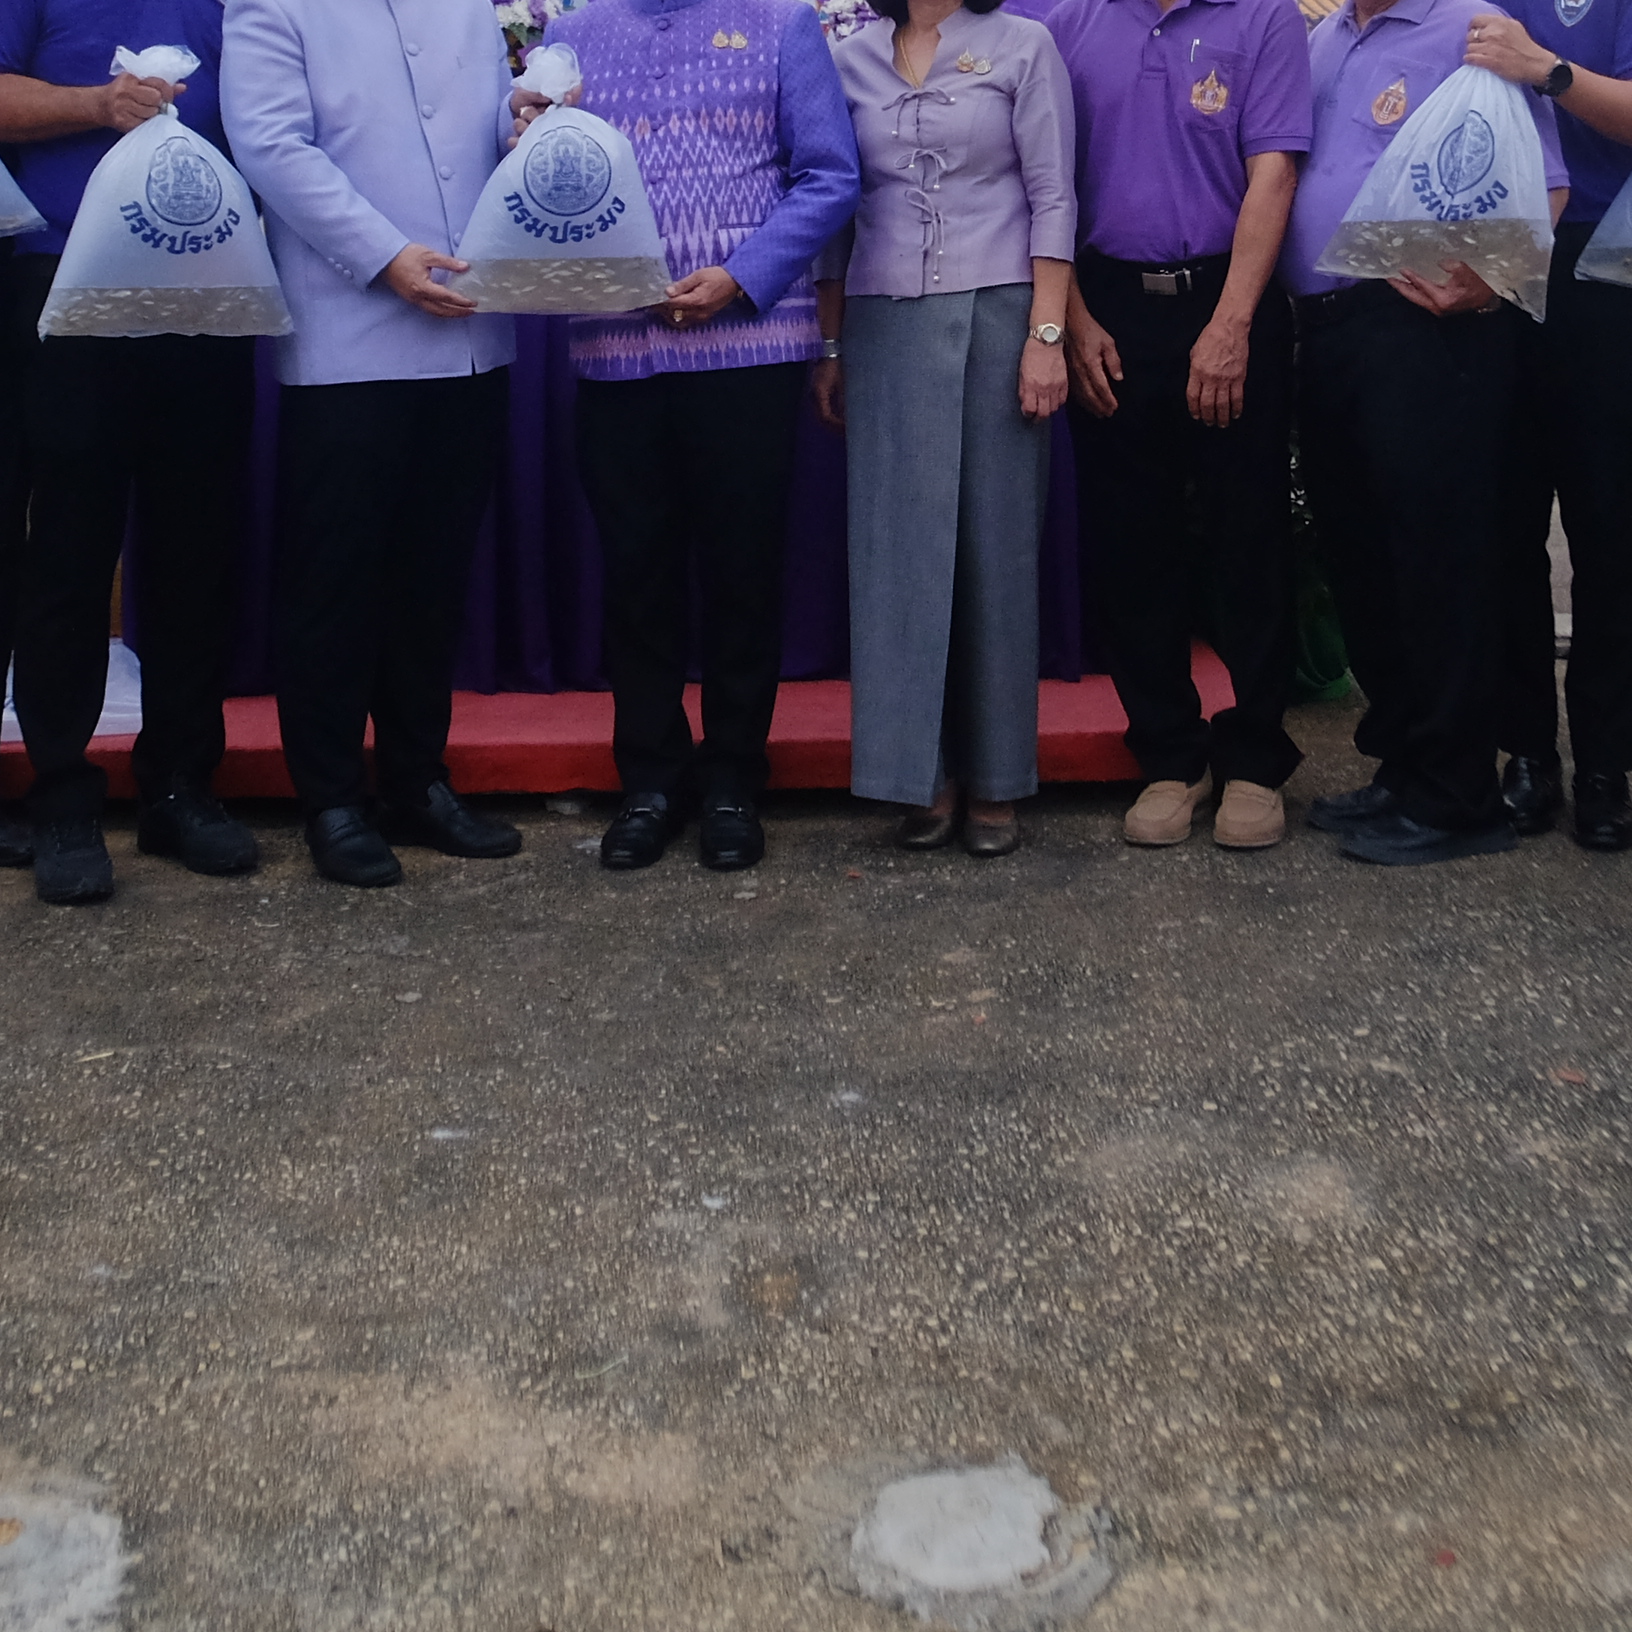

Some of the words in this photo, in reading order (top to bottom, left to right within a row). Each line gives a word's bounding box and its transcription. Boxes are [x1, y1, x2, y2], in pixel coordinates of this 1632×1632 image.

[120, 201, 241, 255] กรมประมง
[503, 191, 626, 244] กรมประมง
